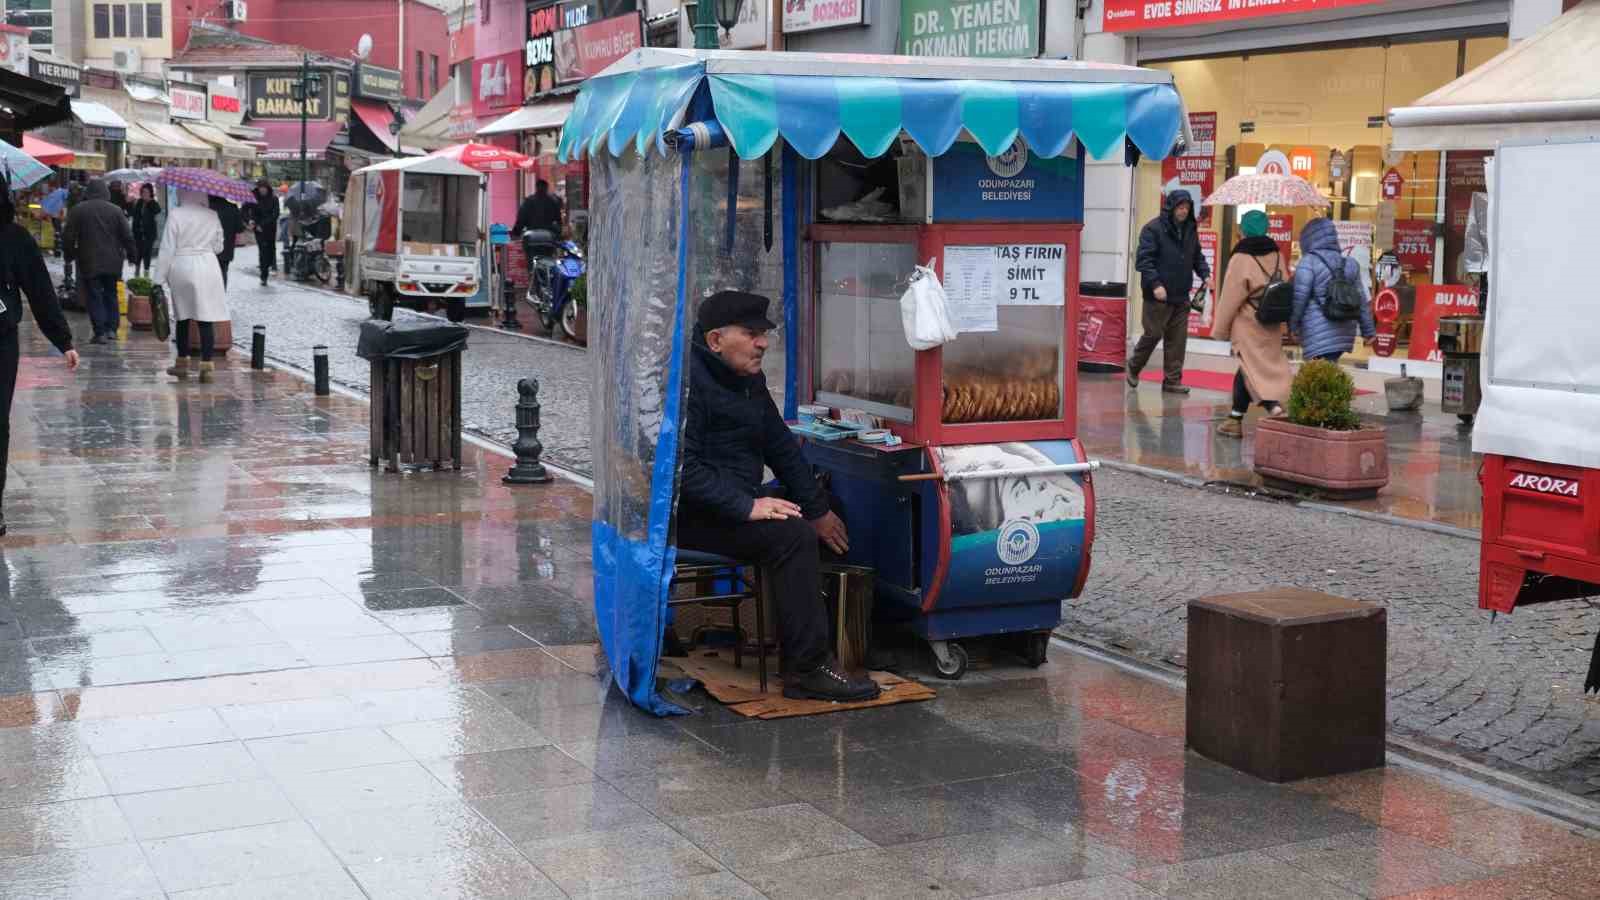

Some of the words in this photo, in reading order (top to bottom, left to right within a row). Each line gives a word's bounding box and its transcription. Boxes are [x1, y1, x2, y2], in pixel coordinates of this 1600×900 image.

[913, 10, 945, 36] DR.
[951, 0, 1020, 30] YEMEN
[1144, 2, 1171, 20] EVDE
[976, 24, 1030, 55] HEKİM
[527, 37, 553, 67] BEYAZ
[978, 179, 1035, 189] ODUNPAZARI
[982, 189, 1032, 201] BELEDİYESİ
[1025, 246, 1062, 260] FIRIN
[1007, 264, 1046, 281] SİMİT
[1010, 287, 1018, 300] 9
[1022, 287, 1040, 300] TL
[1436, 292, 1454, 305] BU
[1510, 472, 1579, 496] ARORA
[984, 564, 1042, 576] ODUNPAZARI
